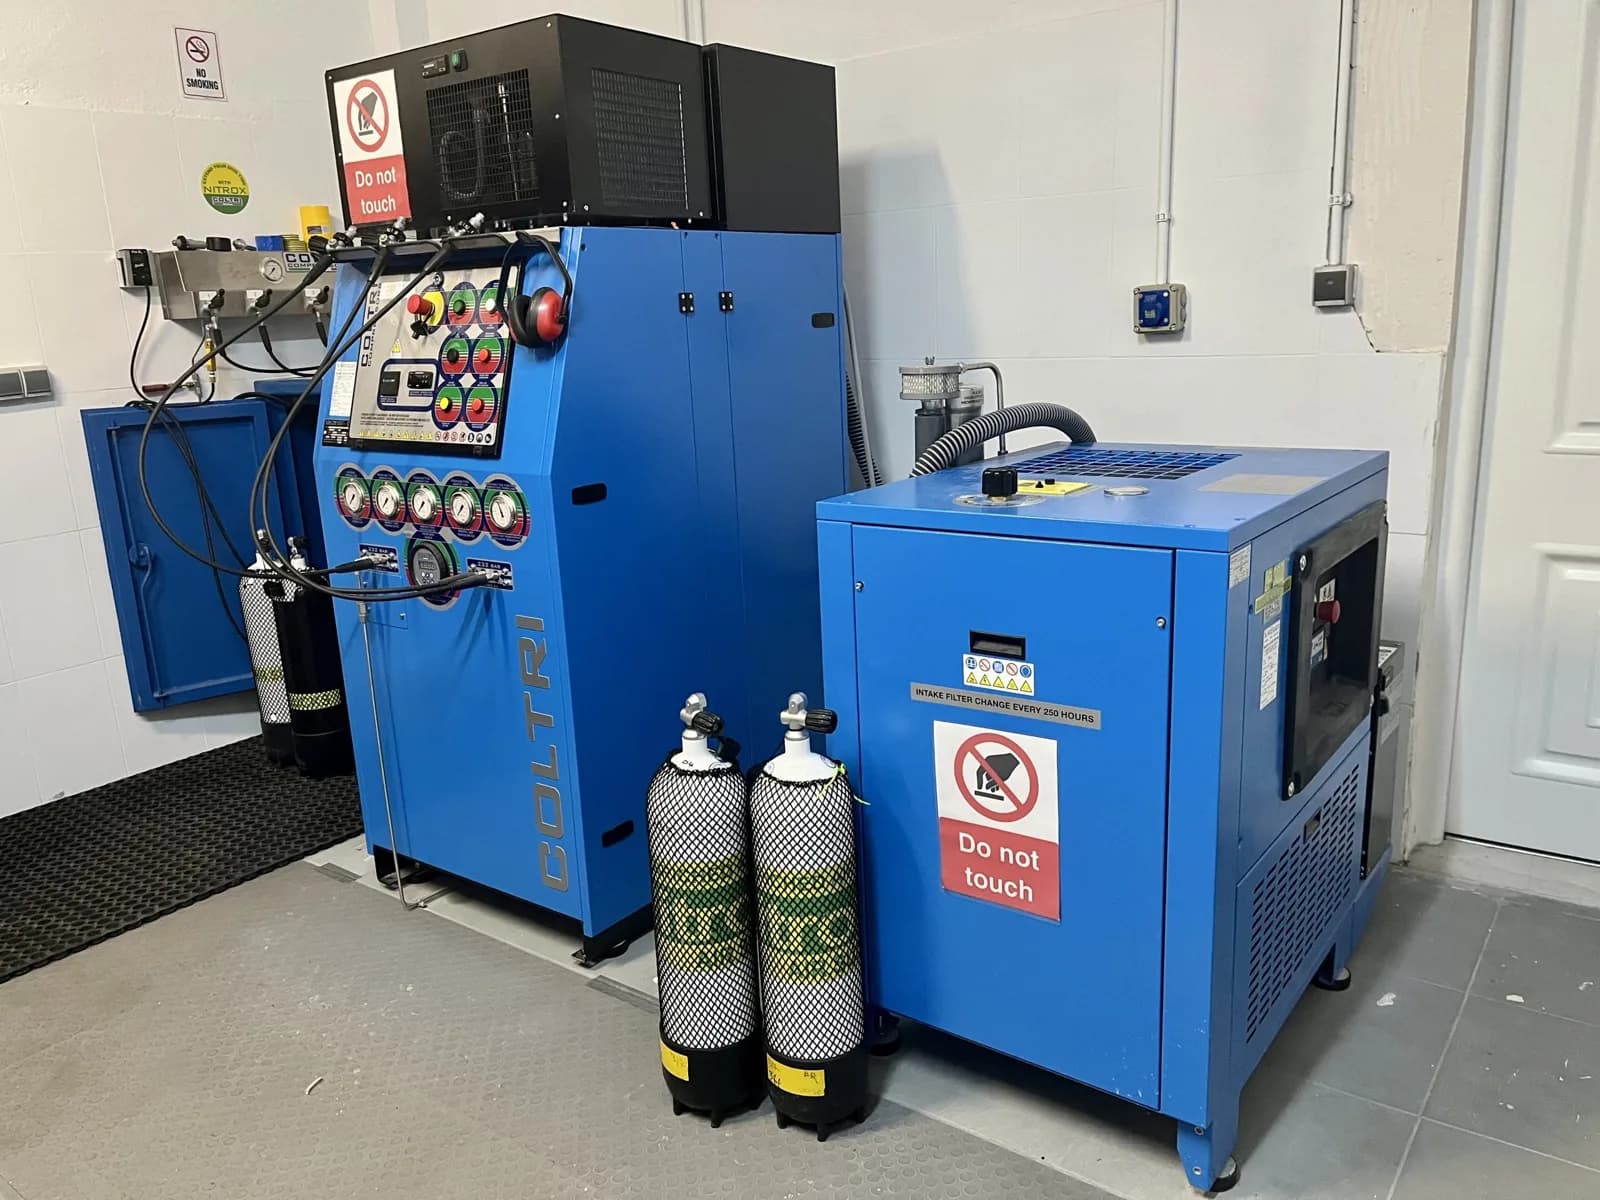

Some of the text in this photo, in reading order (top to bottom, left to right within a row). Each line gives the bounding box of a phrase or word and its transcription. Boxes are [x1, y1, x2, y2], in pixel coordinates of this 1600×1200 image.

[186, 78, 218, 90] SMOKING
[196, 68, 206, 78] NO
[355, 166, 396, 188] Do not
[203, 186, 246, 194] NITROX
[361, 194, 396, 215] touch
[915, 688, 1095, 723] INTAKE FILTER CHANGE EVERY 250 HOURS
[515, 614, 569, 892] COLTRI
[959, 831, 1040, 871] Do not
[964, 866, 1033, 902] touch
